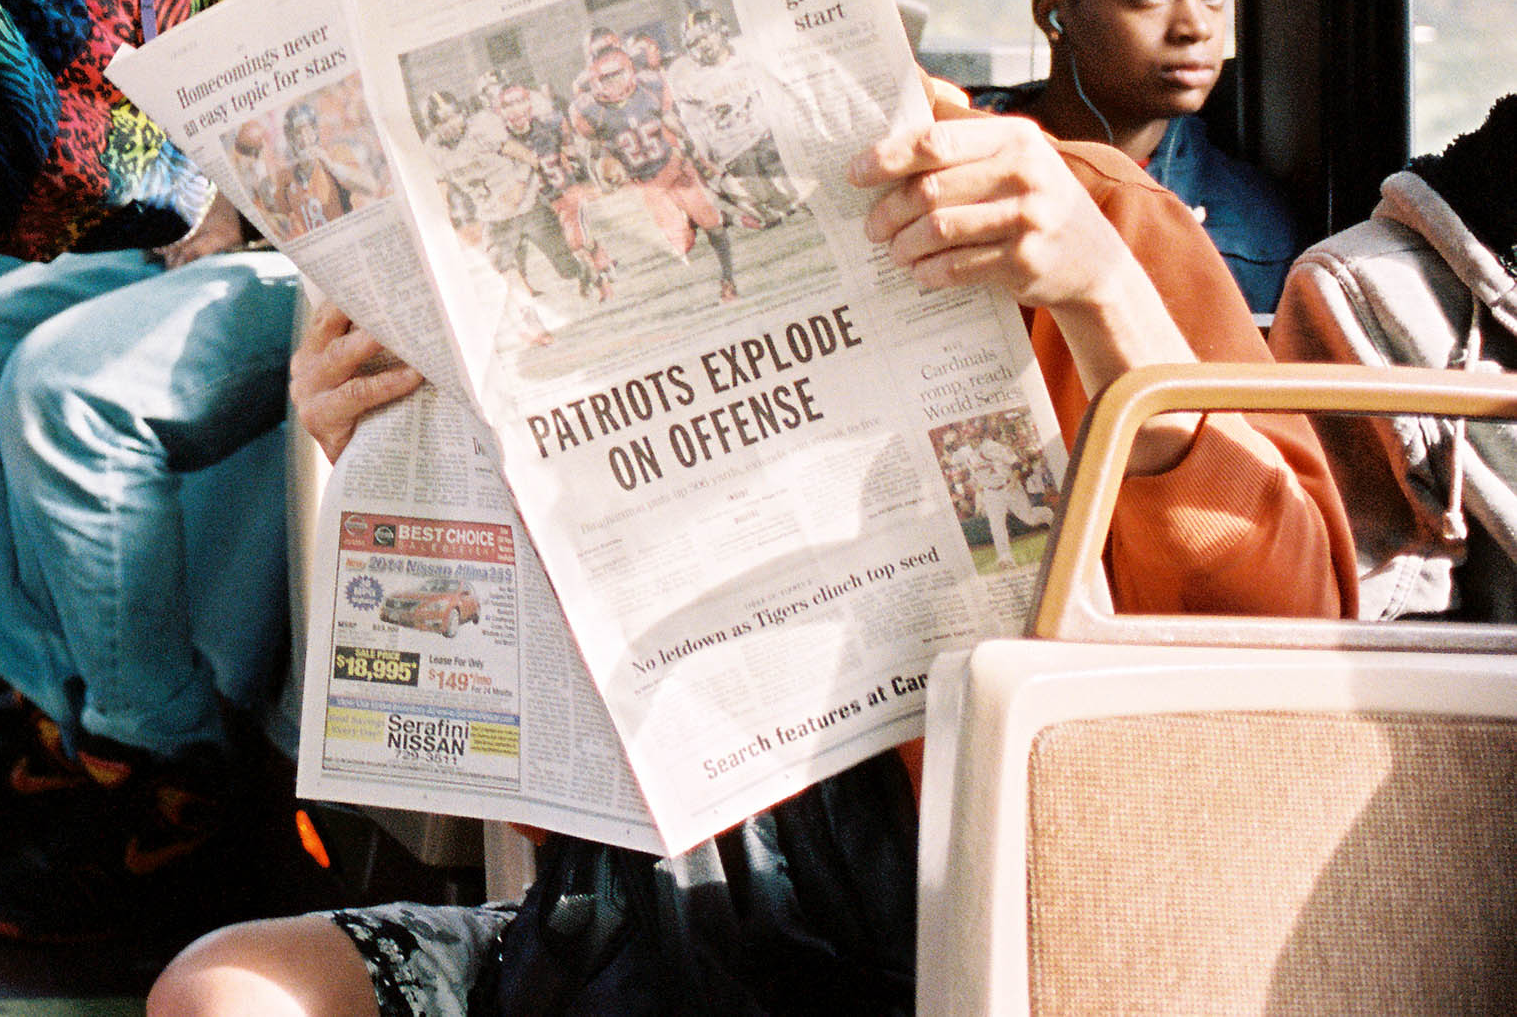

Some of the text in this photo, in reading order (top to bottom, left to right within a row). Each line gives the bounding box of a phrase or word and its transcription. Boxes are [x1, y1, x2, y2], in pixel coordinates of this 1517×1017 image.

[794, 2, 845, 32] start
[177, 48, 279, 109] Homecomings
[283, 25, 328, 58] never
[183, 47, 347, 138] an easy topic for stars
[527, 365, 694, 458] PATRIOTS
[701, 305, 862, 393] EXPLODE
[921, 348, 998, 380] Cardinals
[920, 364, 1014, 402] romp, reach
[923, 386, 1023, 422] World Series
[609, 436, 663, 491] ON
[669, 377, 823, 468] OFFENSE
[398, 525, 445, 542] BEST
[446, 529, 495, 547] CHOICE
[406, 560, 452, 576] Nissan
[632, 659, 656, 674] No
[659, 630, 727, 665] letdown
[731, 621, 752, 638] as
[753, 599, 809, 628] Tigers
[812, 574, 862, 606] clinch
[867, 563, 895, 583] top
[899, 546, 940, 570] seed
[429, 655, 453, 666] Lease
[387, 732, 465, 756] NISSAN
[388, 714, 470, 739] Serafini
[703, 734, 772, 779] Search
[775, 699, 862, 745] features
[866, 685, 888, 707] at
